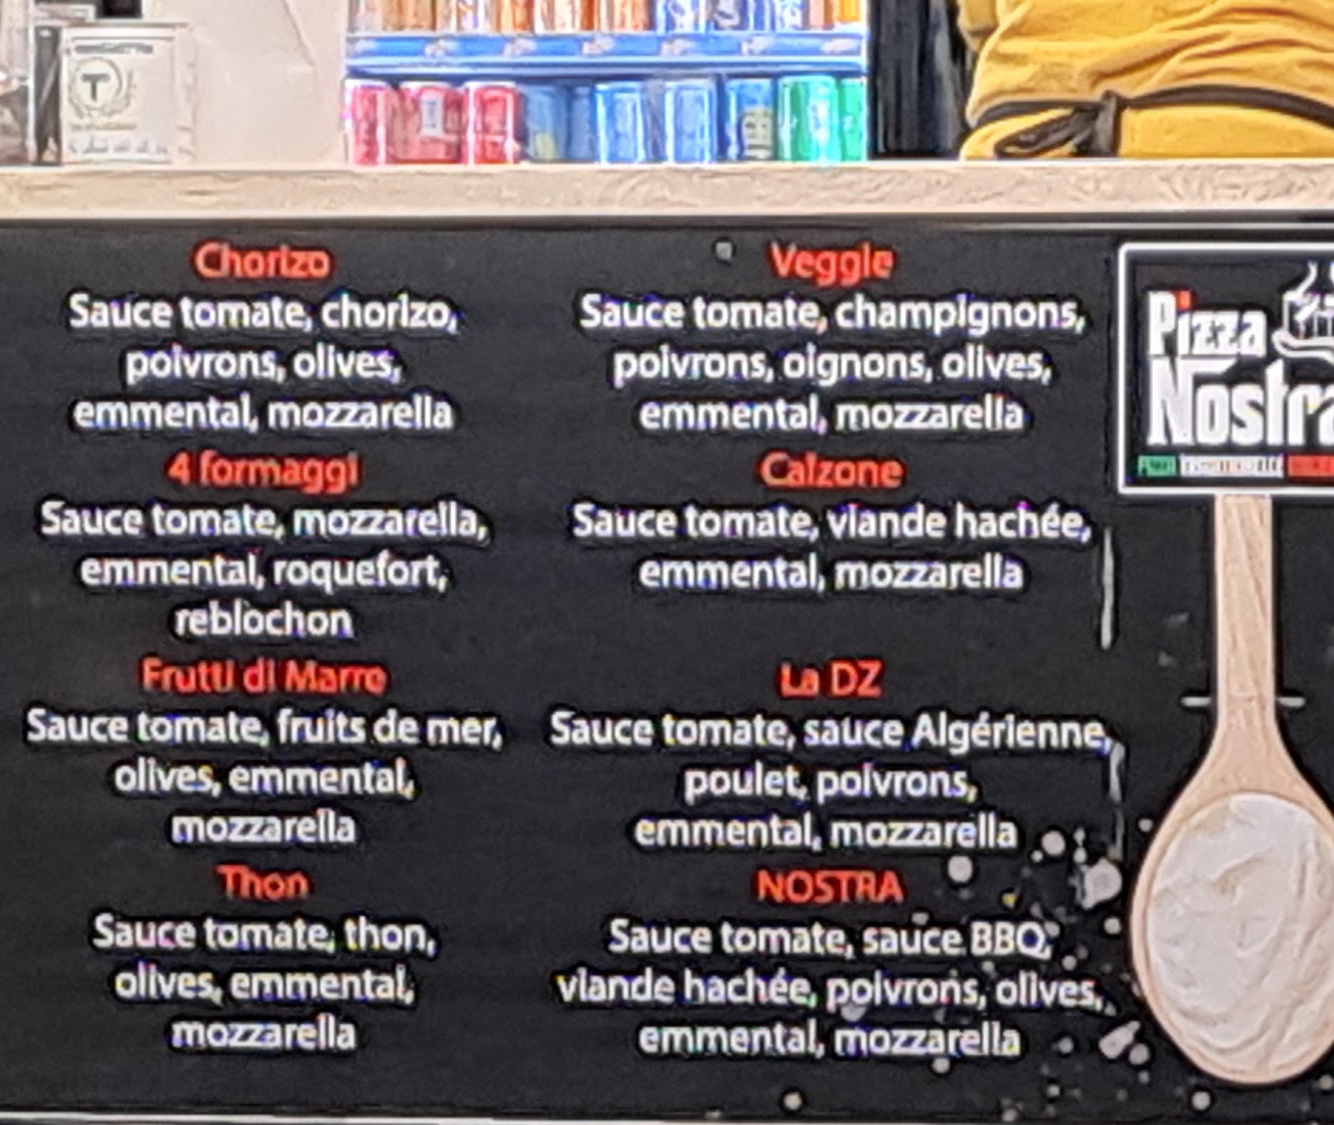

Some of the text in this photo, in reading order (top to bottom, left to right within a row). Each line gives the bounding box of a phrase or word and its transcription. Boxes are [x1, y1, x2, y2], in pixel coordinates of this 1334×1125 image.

[195, 242, 332, 279] Chorizo
[770, 242, 895, 286] Veggie
[69, 292, 458, 333] Sauce tomate, chorizo,
[580, 293, 1086, 335] Sauce tomate, champignons,
[1147, 290, 1267, 357] Pizza
[126, 343, 401, 385] poivrons, olives,
[613, 345, 1052, 386] poivrons, oignons, olives,
[168, 450, 358, 493] 4 formaggi
[761, 452, 905, 488] Calzone
[41, 501, 487, 542] Sauce tomate, mozzarella,
[81, 550, 448, 594] emmental, roquefort,
[175, 601, 352, 637] reblochon
[142, 657, 235, 693] Frutti
[242, 657, 276, 693] di
[780, 661, 882, 697] La DZ
[27, 707, 502, 748] Sauce tomate, fruits de mer,
[551, 710, 1114, 754] Sauce tomate, sauce Algérienne,
[685, 762, 977, 804] poulet, poivrons,
[218, 864, 311, 900] Thon
[757, 869, 905, 903] NOSTRA
[93, 914, 435, 954] Sauce tomate, thon,
[609, 918, 712, 955] Sauce
[721, 921, 854, 960] tomate,
[863, 918, 965, 957] sauce
[557, 968, 1103, 1009] viande hachée, poivrons, olives,
[639, 1021, 1020, 1059] emmental, mozzarella
